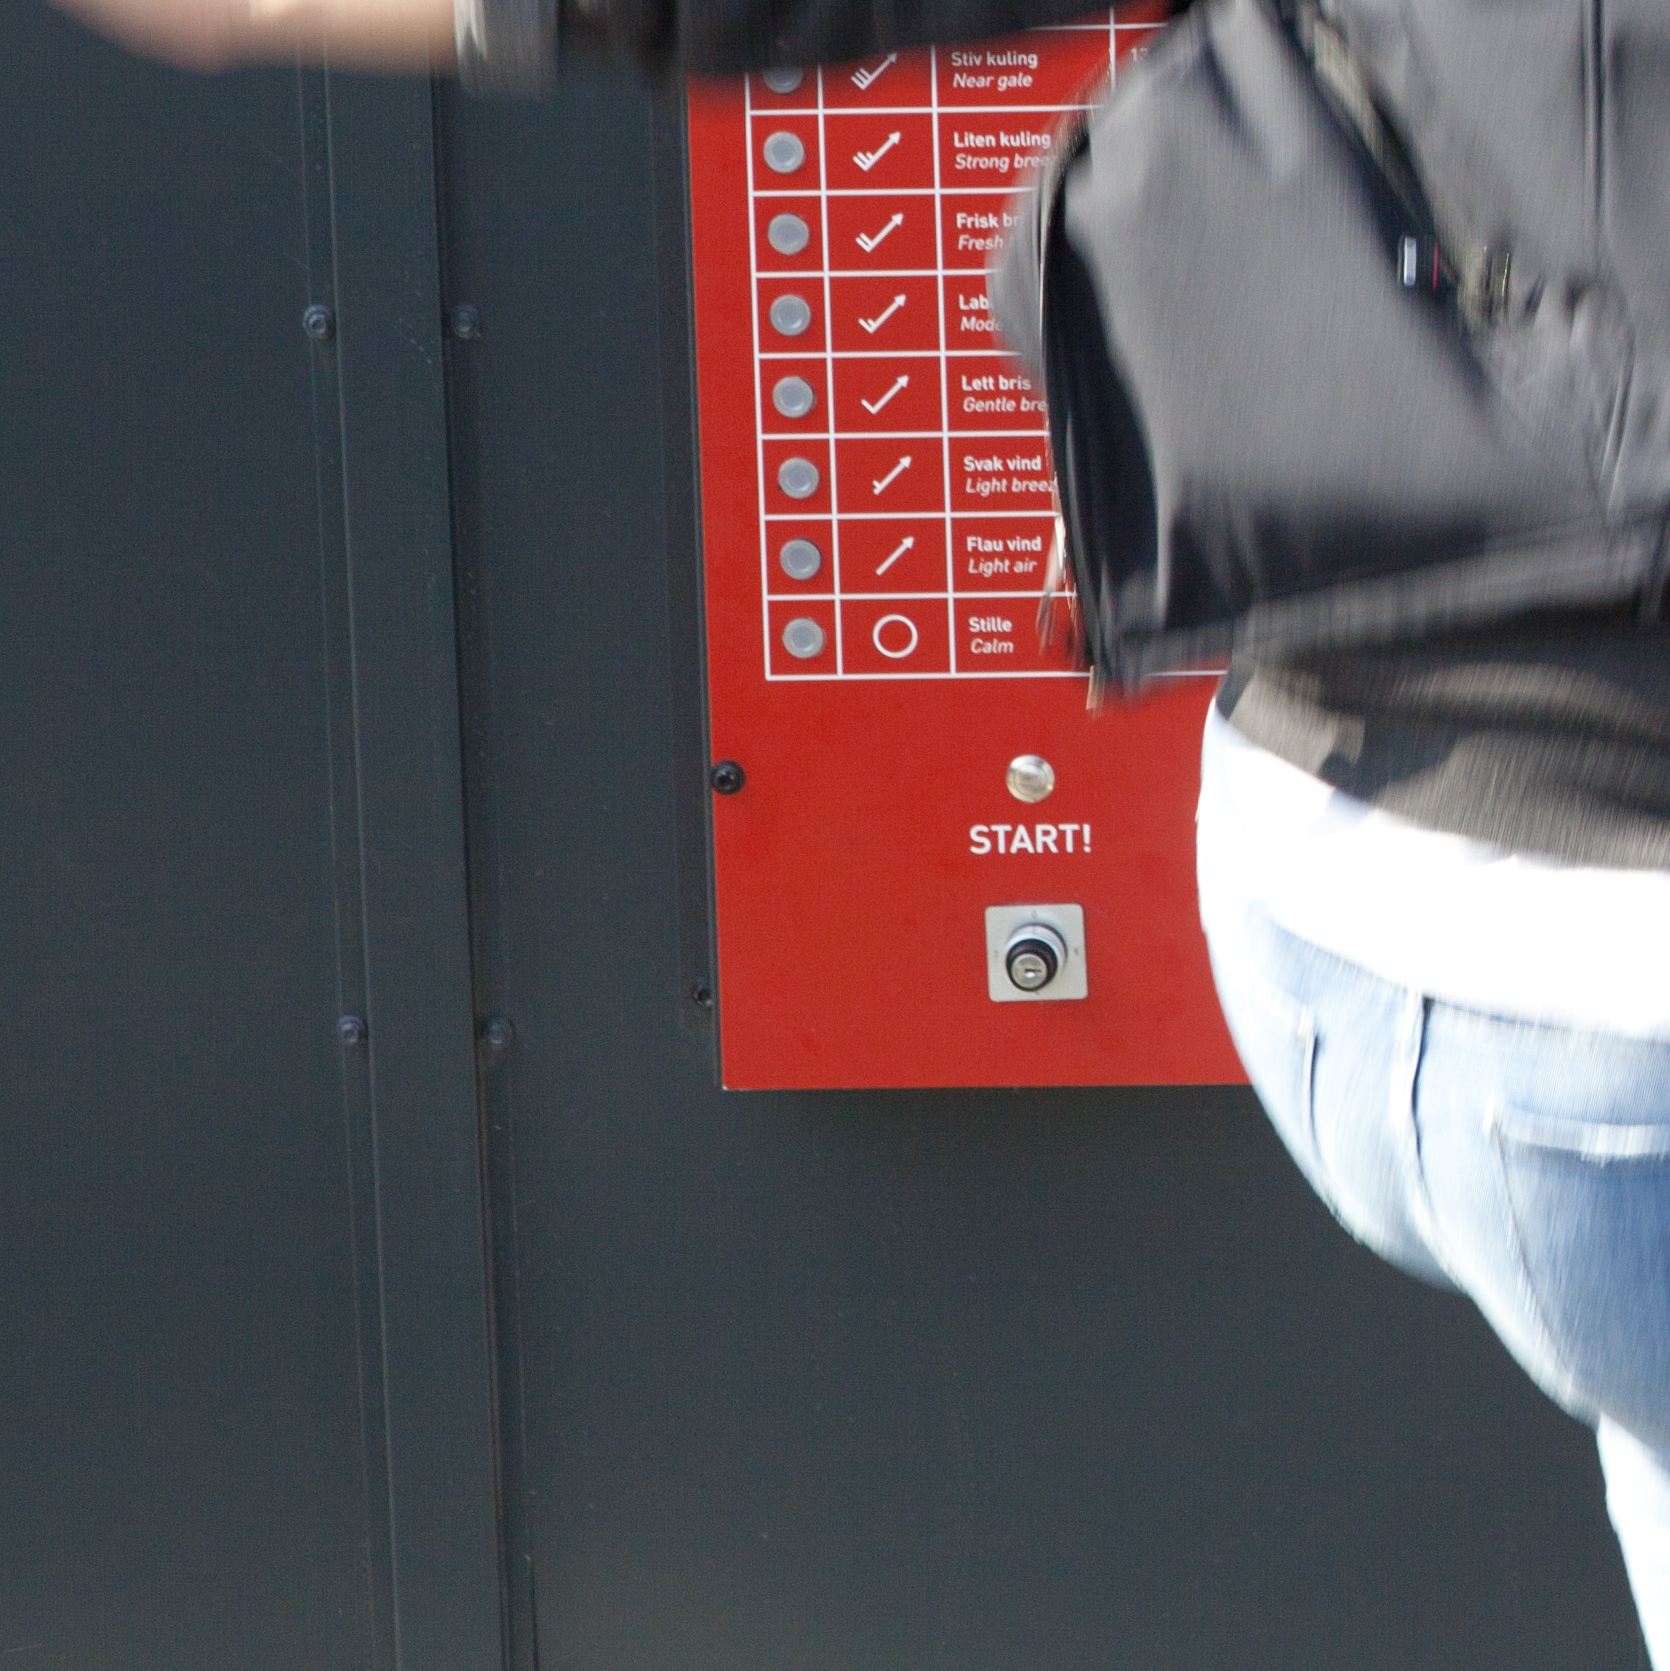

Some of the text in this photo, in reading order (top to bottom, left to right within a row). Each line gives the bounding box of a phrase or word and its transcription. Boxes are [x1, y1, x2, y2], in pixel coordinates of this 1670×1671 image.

[951, 51, 1038, 69] Stiv kuling
[952, 72, 1033, 91] Near gale
[953, 131, 1051, 150] Liten kuling
[954, 153, 1055, 173] Strong bree
[956, 212, 1000, 229] Frisk
[958, 235, 1004, 250] Fresh
[958, 294, 992, 310] Lab
[961, 375, 1031, 392] Lett bris
[962, 396, 1048, 413] Gentle bre
[963, 455, 1042, 472] Svak vind
[965, 477, 1008, 498] Light
[966, 535, 1042, 552] Flau vind
[968, 557, 1038, 578] Light air
[968, 616, 1013, 633] Stille
[970, 637, 1014, 654] Calm
[969, 823, 1091, 855] START!
